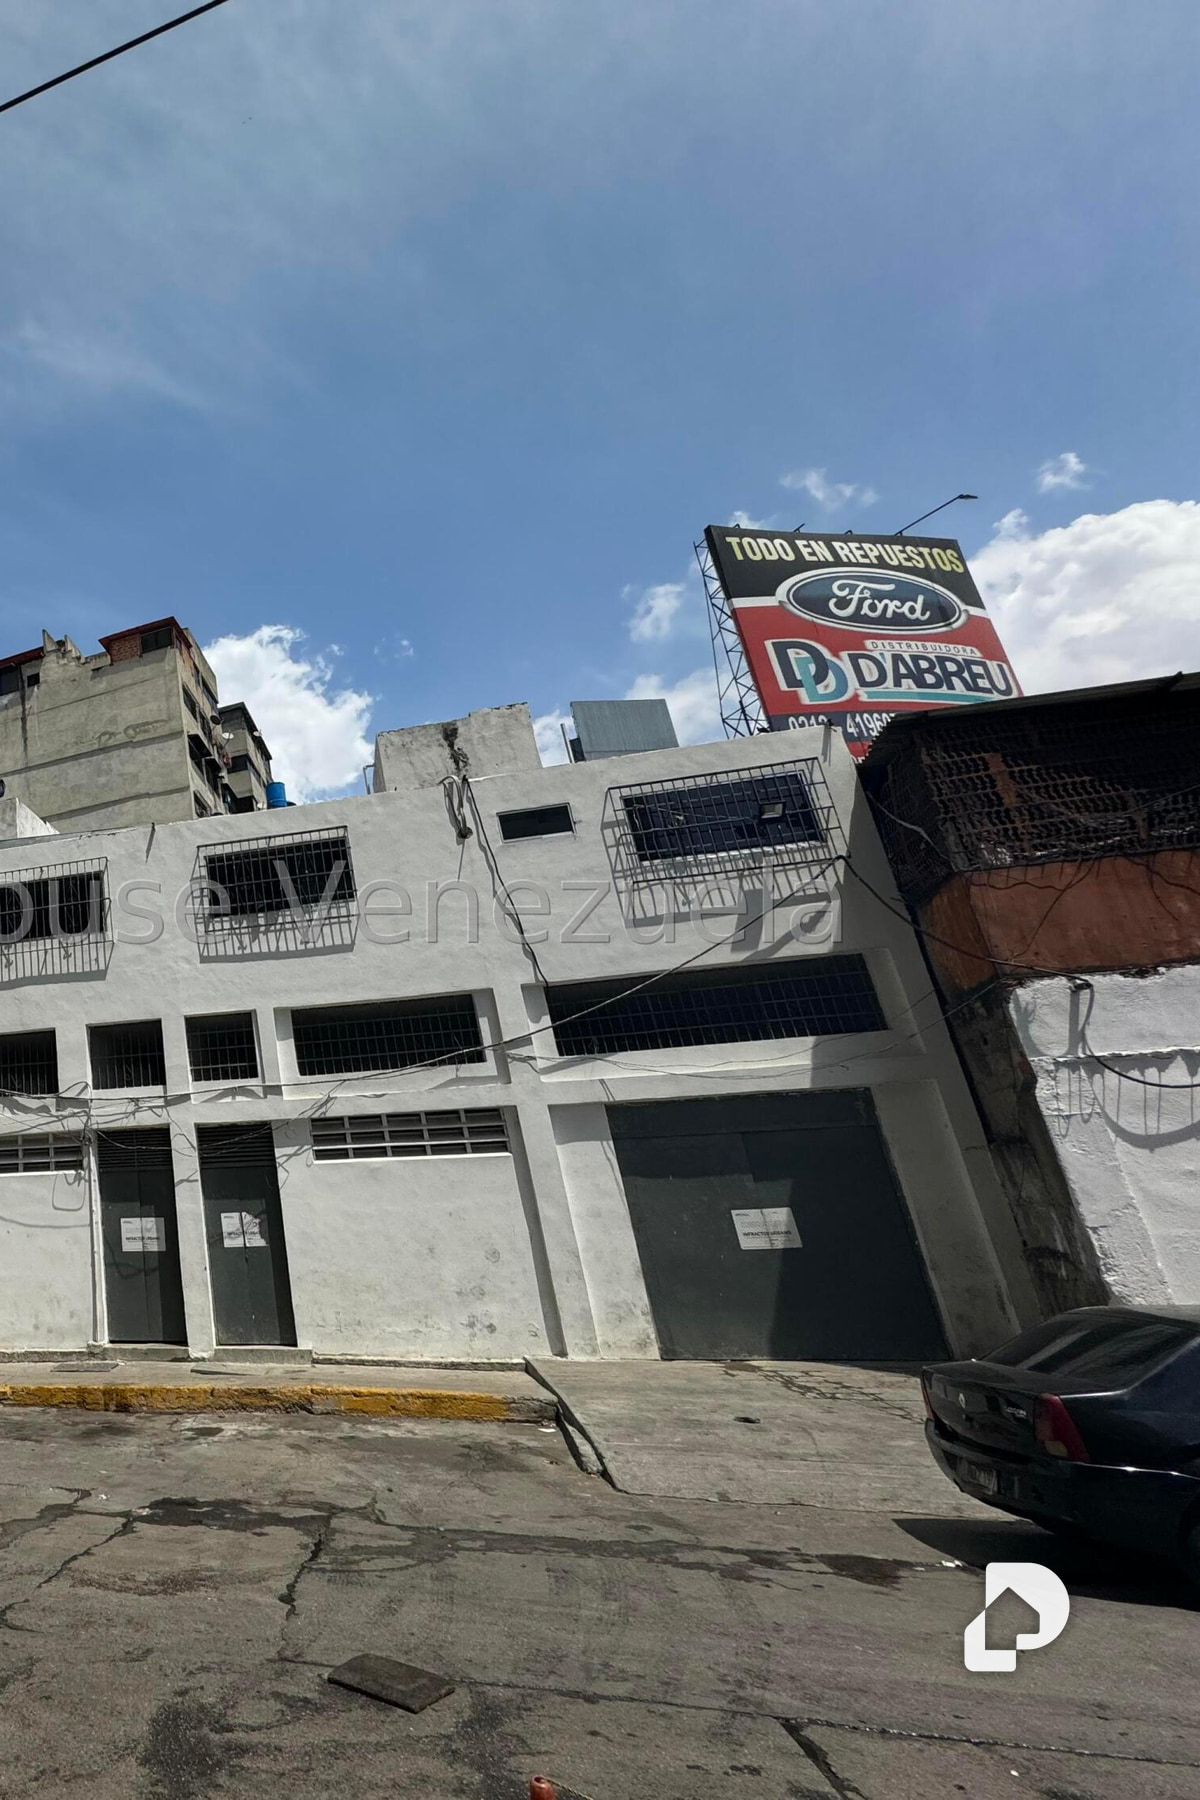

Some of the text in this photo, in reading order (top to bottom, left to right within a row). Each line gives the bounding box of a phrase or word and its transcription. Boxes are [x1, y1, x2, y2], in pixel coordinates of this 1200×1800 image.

[726, 536, 964, 573] TODO EN REPUESTOS
[828, 579, 930, 621] Ford
[871, 641, 977, 656] DISTRIBUIDORA
